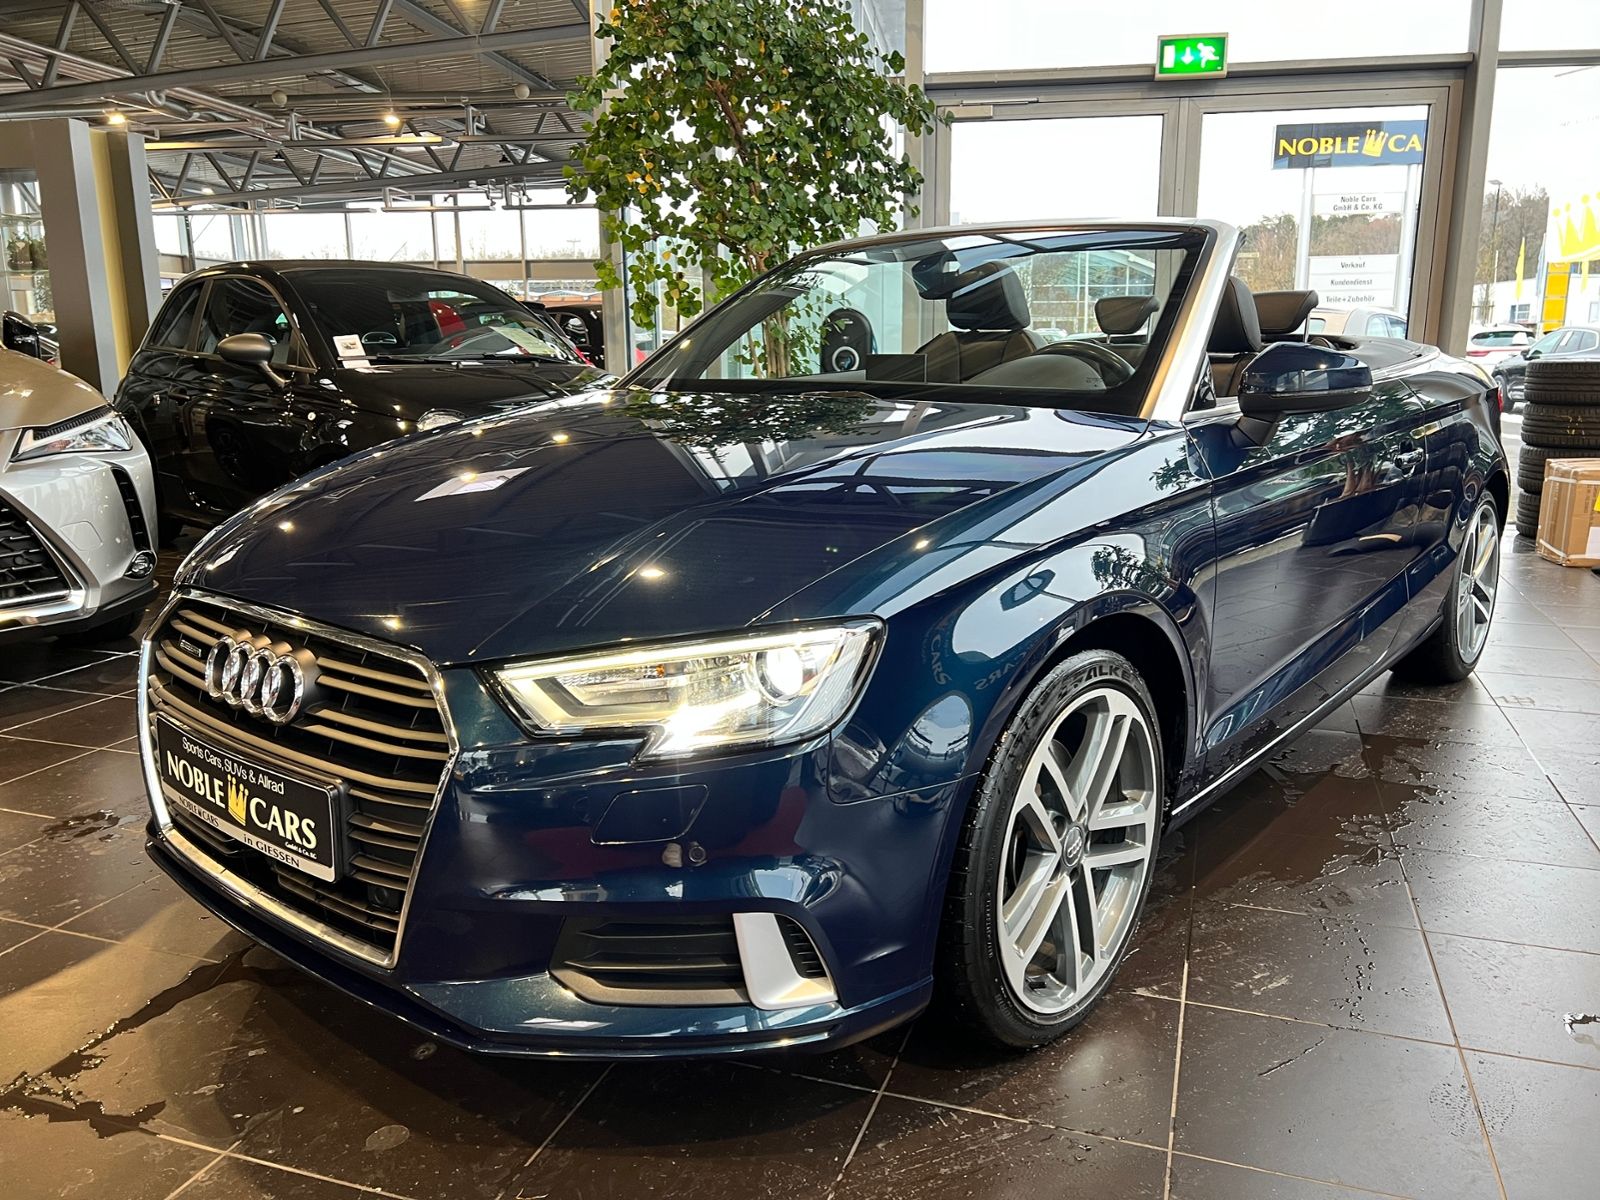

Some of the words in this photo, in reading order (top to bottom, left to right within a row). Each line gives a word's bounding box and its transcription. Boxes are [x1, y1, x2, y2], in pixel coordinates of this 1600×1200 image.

[1278, 136, 1360, 155] NOBLE
[182, 736, 204, 759] Sports
[204, 749, 224, 771] Cars,
[224, 759, 248, 780] SUVs
[248, 769, 257, 784] &
[257, 773, 285, 795] Allrad
[167, 750, 226, 809] NOBLE
[250, 797, 317, 849] CARS
[243, 834, 253, 846] in
[255, 840, 300, 868] GIESSEN
